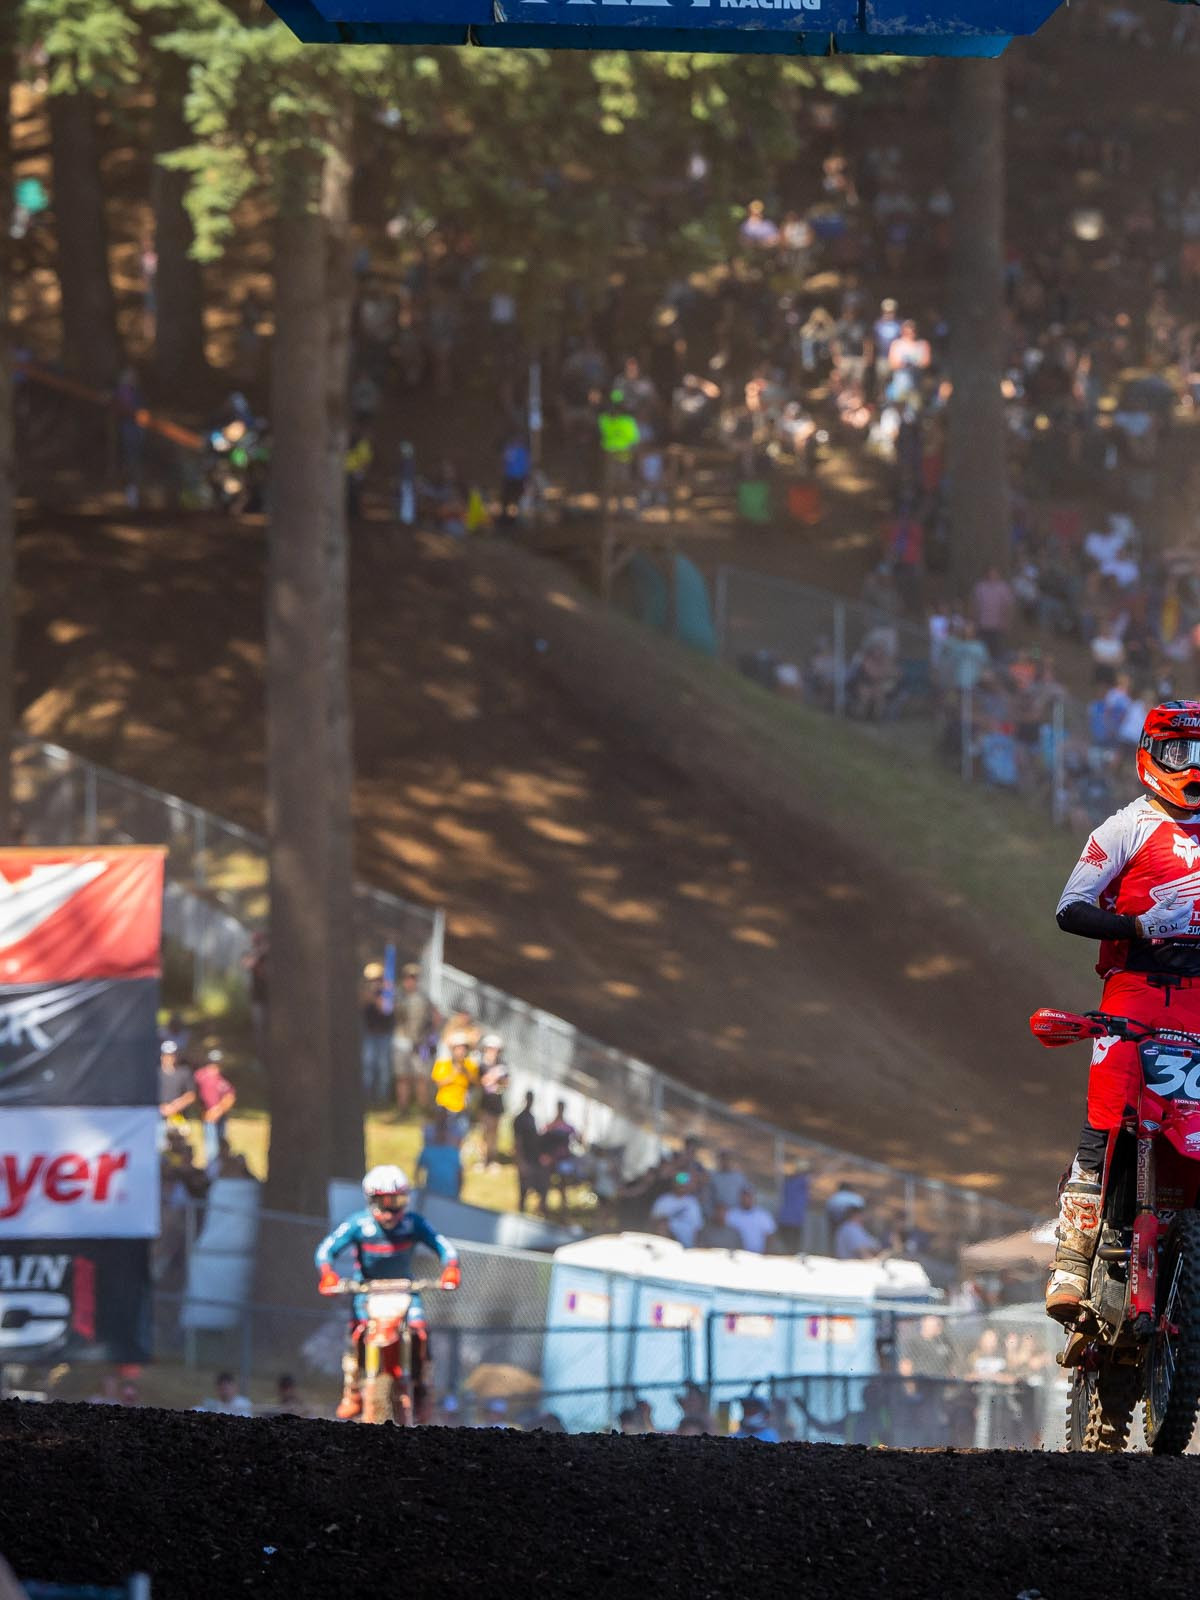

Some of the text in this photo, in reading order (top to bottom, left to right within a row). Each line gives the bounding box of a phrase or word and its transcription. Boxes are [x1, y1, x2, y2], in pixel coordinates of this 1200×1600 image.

[1148, 923, 1178, 935] FOX
[0, 1151, 128, 1220] yer
[1132, 1232, 1141, 1295] DUNLOP
